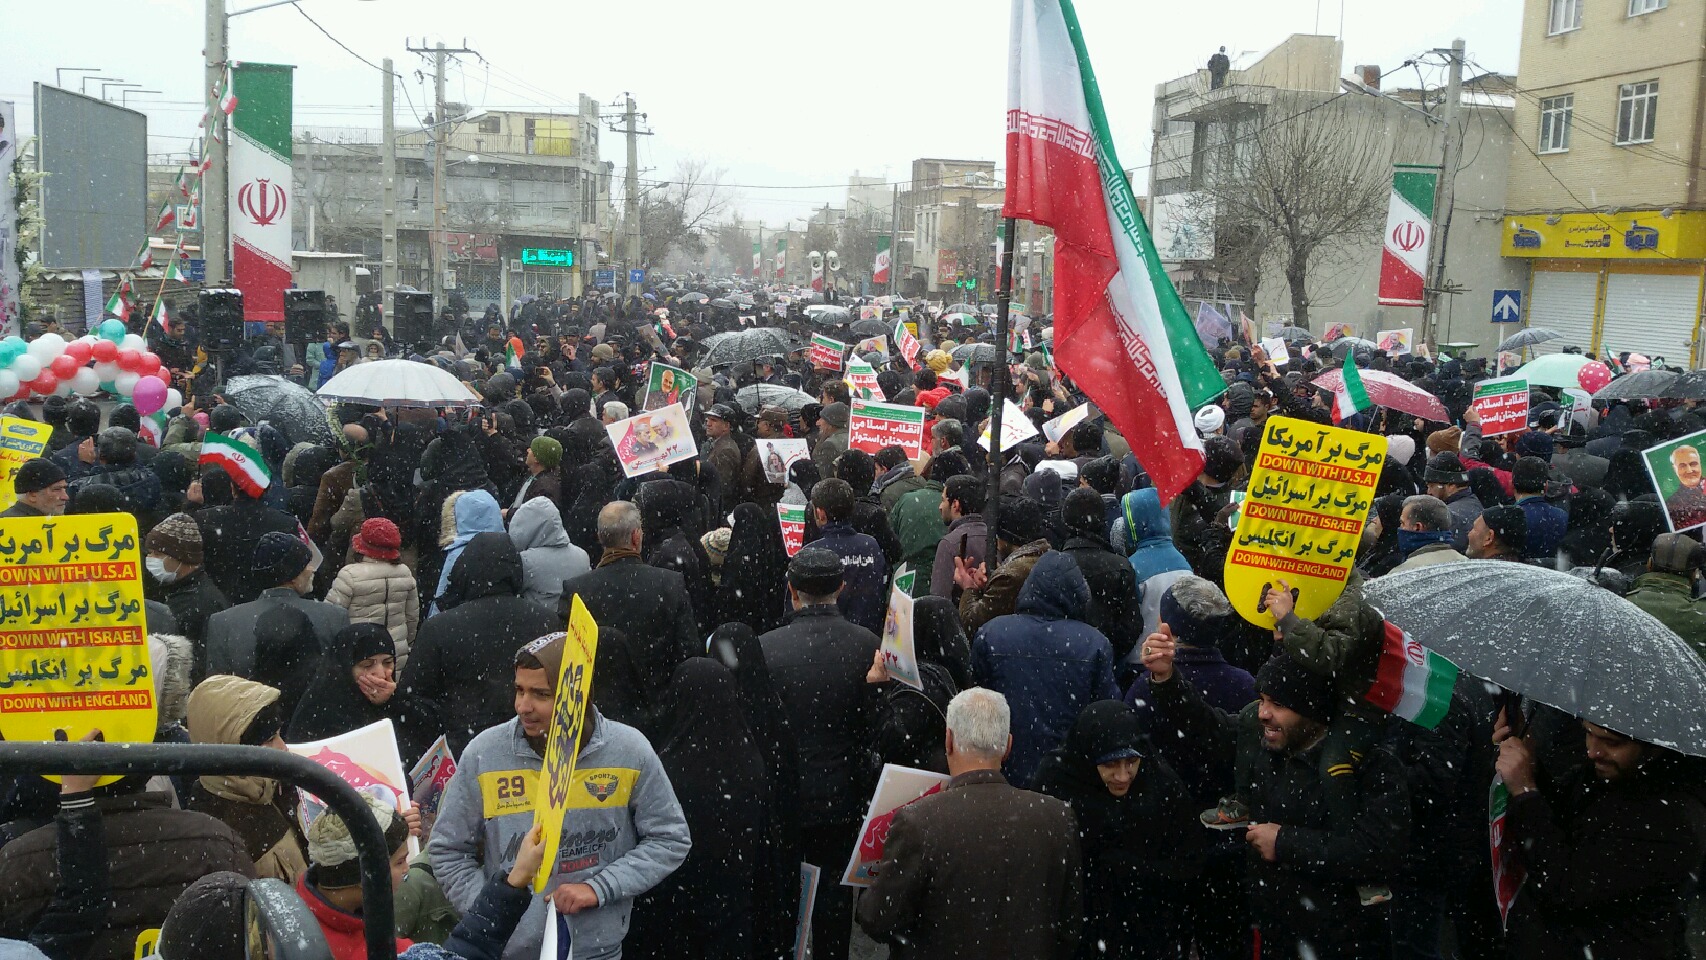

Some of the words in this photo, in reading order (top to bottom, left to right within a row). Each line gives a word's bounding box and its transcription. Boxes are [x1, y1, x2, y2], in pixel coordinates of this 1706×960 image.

[1475, 396, 1504, 411] اسلام
[1505, 392, 1527, 408] انقلاب
[851, 419, 888, 431] اسلامی
[1500, 409, 1527, 423] همچنان
[851, 431, 880, 444] استوار
[890, 424, 921, 435] انقلاب
[1266, 425, 1330, 458] آمریکا
[1321, 443, 1342, 463] بر
[1344, 442, 1382, 470] مرگ
[1262, 454, 1304, 473] DOWN
[1305, 461, 1340, 479] WITH
[1340, 469, 1373, 485] U.S.A
[1251, 475, 1315, 504] اسرائیل
[1311, 491, 1331, 510] بر
[1333, 491, 1368, 515] مرگ
[1248, 504, 1288, 522] DOWN
[1288, 510, 1319, 527] WITH
[1319, 514, 1359, 533] ISRAEL
[59, 533, 80, 563] بر
[85, 524, 135, 560] مرگ
[1238, 528, 1296, 549] انگلیس
[1294, 539, 1313, 556] بر
[1316, 538, 1354, 563] مرگ
[0, 568, 41, 583] OWN
[43, 566, 87, 581] WITH
[91, 565, 134, 580] U.S.A
[1235, 551, 1269, 567] DOWN
[1268, 557, 1296, 571] WITH
[1296, 563, 1346, 579] ENGLAND
[70, 598, 89, 624] بر
[94, 590, 140, 621] مرگ
[45, 632, 85, 646] WITH
[89, 630, 142, 645] ISRAEL
[0, 657, 67, 688] انگلیس
[75, 663, 92, 687] بر
[98, 656, 148, 686] مرگ
[3, 696, 45, 710] DOWN
[46, 695, 84, 709] WITH
[85, 694, 148, 708] ENGLAND
[497, 775, 526, 799] 29
[561, 857, 598, 871] YOUNG
